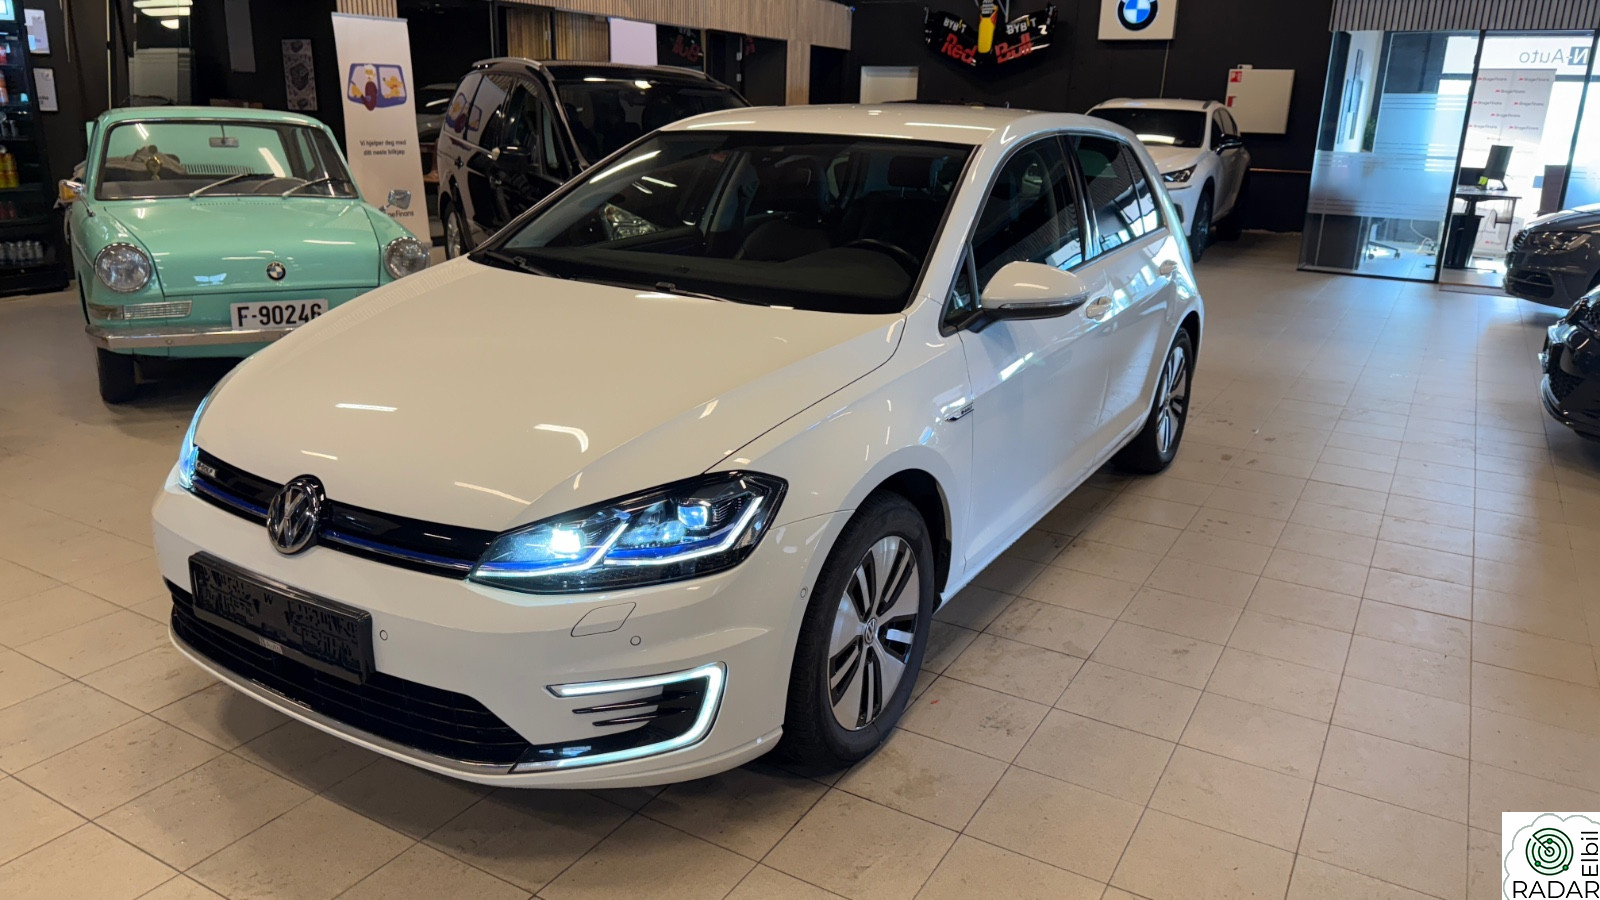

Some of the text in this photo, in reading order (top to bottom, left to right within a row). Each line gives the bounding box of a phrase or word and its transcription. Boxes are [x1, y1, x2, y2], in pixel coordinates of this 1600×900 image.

[943, 17, 967, 34] BYBIT
[1006, 17, 1036, 35] BYBIT
[941, 33, 978, 65] Red
[995, 32, 1033, 63] Bull
